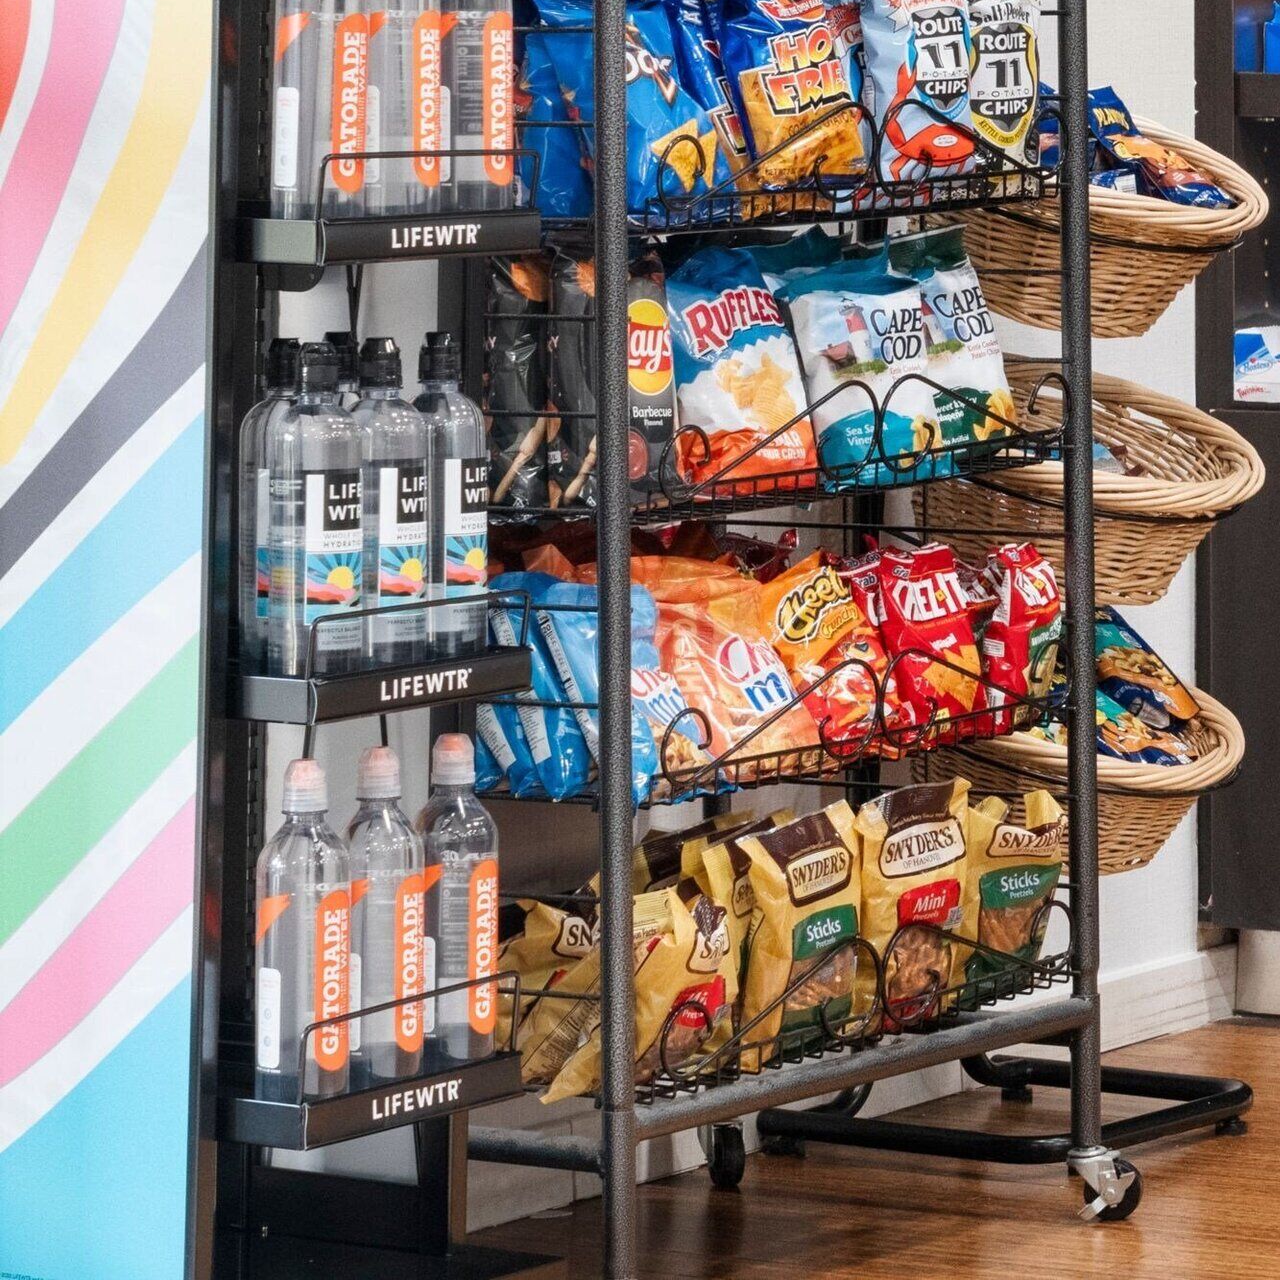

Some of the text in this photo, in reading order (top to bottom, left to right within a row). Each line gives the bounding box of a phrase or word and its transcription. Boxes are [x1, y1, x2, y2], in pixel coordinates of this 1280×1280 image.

[913, 16, 964, 37] ROUTE
[979, 31, 1028, 51] ROUTE
[921, 40, 962, 70] 11
[925, 78, 967, 96] CHIPS
[985, 58, 1023, 89] 11
[339, 31, 362, 177] GATORADE
[420, 28, 439, 171] GATORADE
[490, 29, 509, 170] GATORADE
[980, 99, 1028, 116] CHIPS
[391, 224, 479, 249] LIFEWTR
[932, 286, 987, 319] CAPE
[685, 285, 786, 357] RUFFLES
[870, 307, 923, 337] CAPE
[953, 310, 995, 343] COD
[880, 335, 922, 365] COD
[632, 405, 673, 419] Barbecue
[380, 668, 473, 702] LIFEWTR
[884, 825, 954, 864] SNYDER'S
[792, 852, 847, 887] SNYDER'S
[1000, 867, 1041, 892] Sticks
[914, 889, 947, 913] Mini
[1009, 887, 1034, 900] Pretzels
[806, 919, 842, 942] Sticks
[475, 876, 493, 1019] GATORADE
[401, 891, 421, 1037] GATORADE
[321, 908, 341, 1055] GATORADE
[372, 1078, 463, 1121] LIFEWTR
